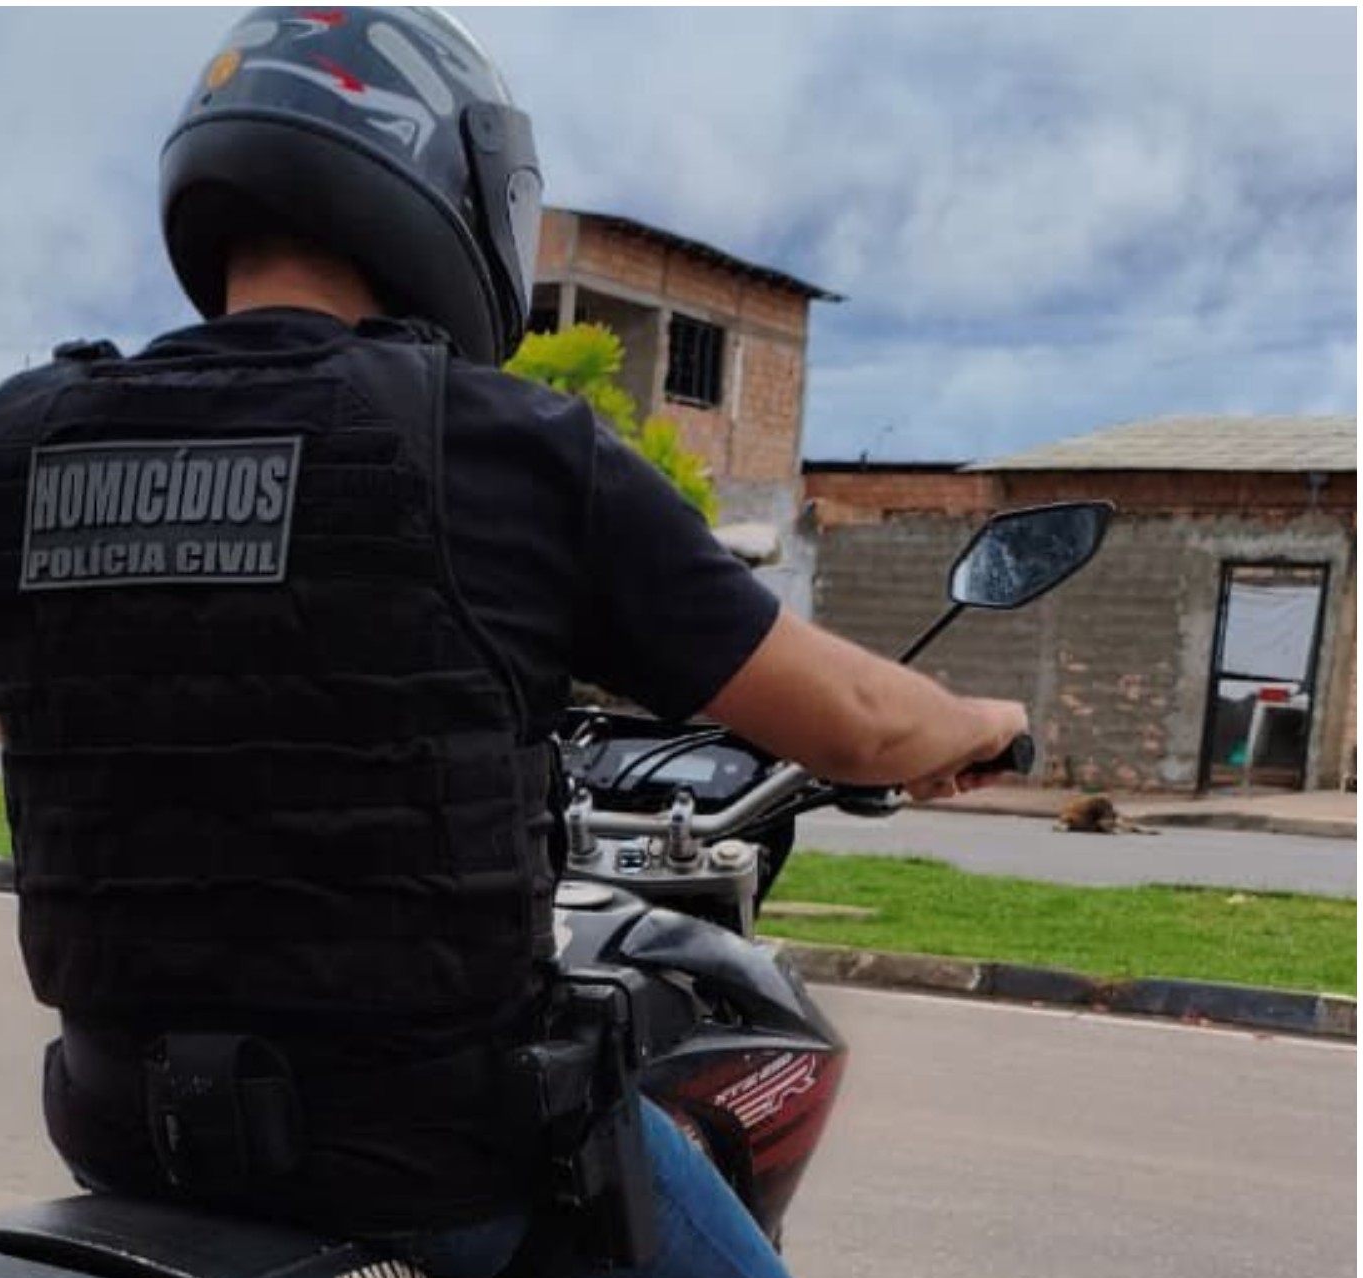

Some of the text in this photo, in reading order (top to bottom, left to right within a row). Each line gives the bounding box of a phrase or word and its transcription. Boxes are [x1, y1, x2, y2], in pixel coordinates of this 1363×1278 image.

[31, 448, 288, 531] HOMICÍDIOS
[27, 540, 277, 580] POLÍCIA CIVIL
